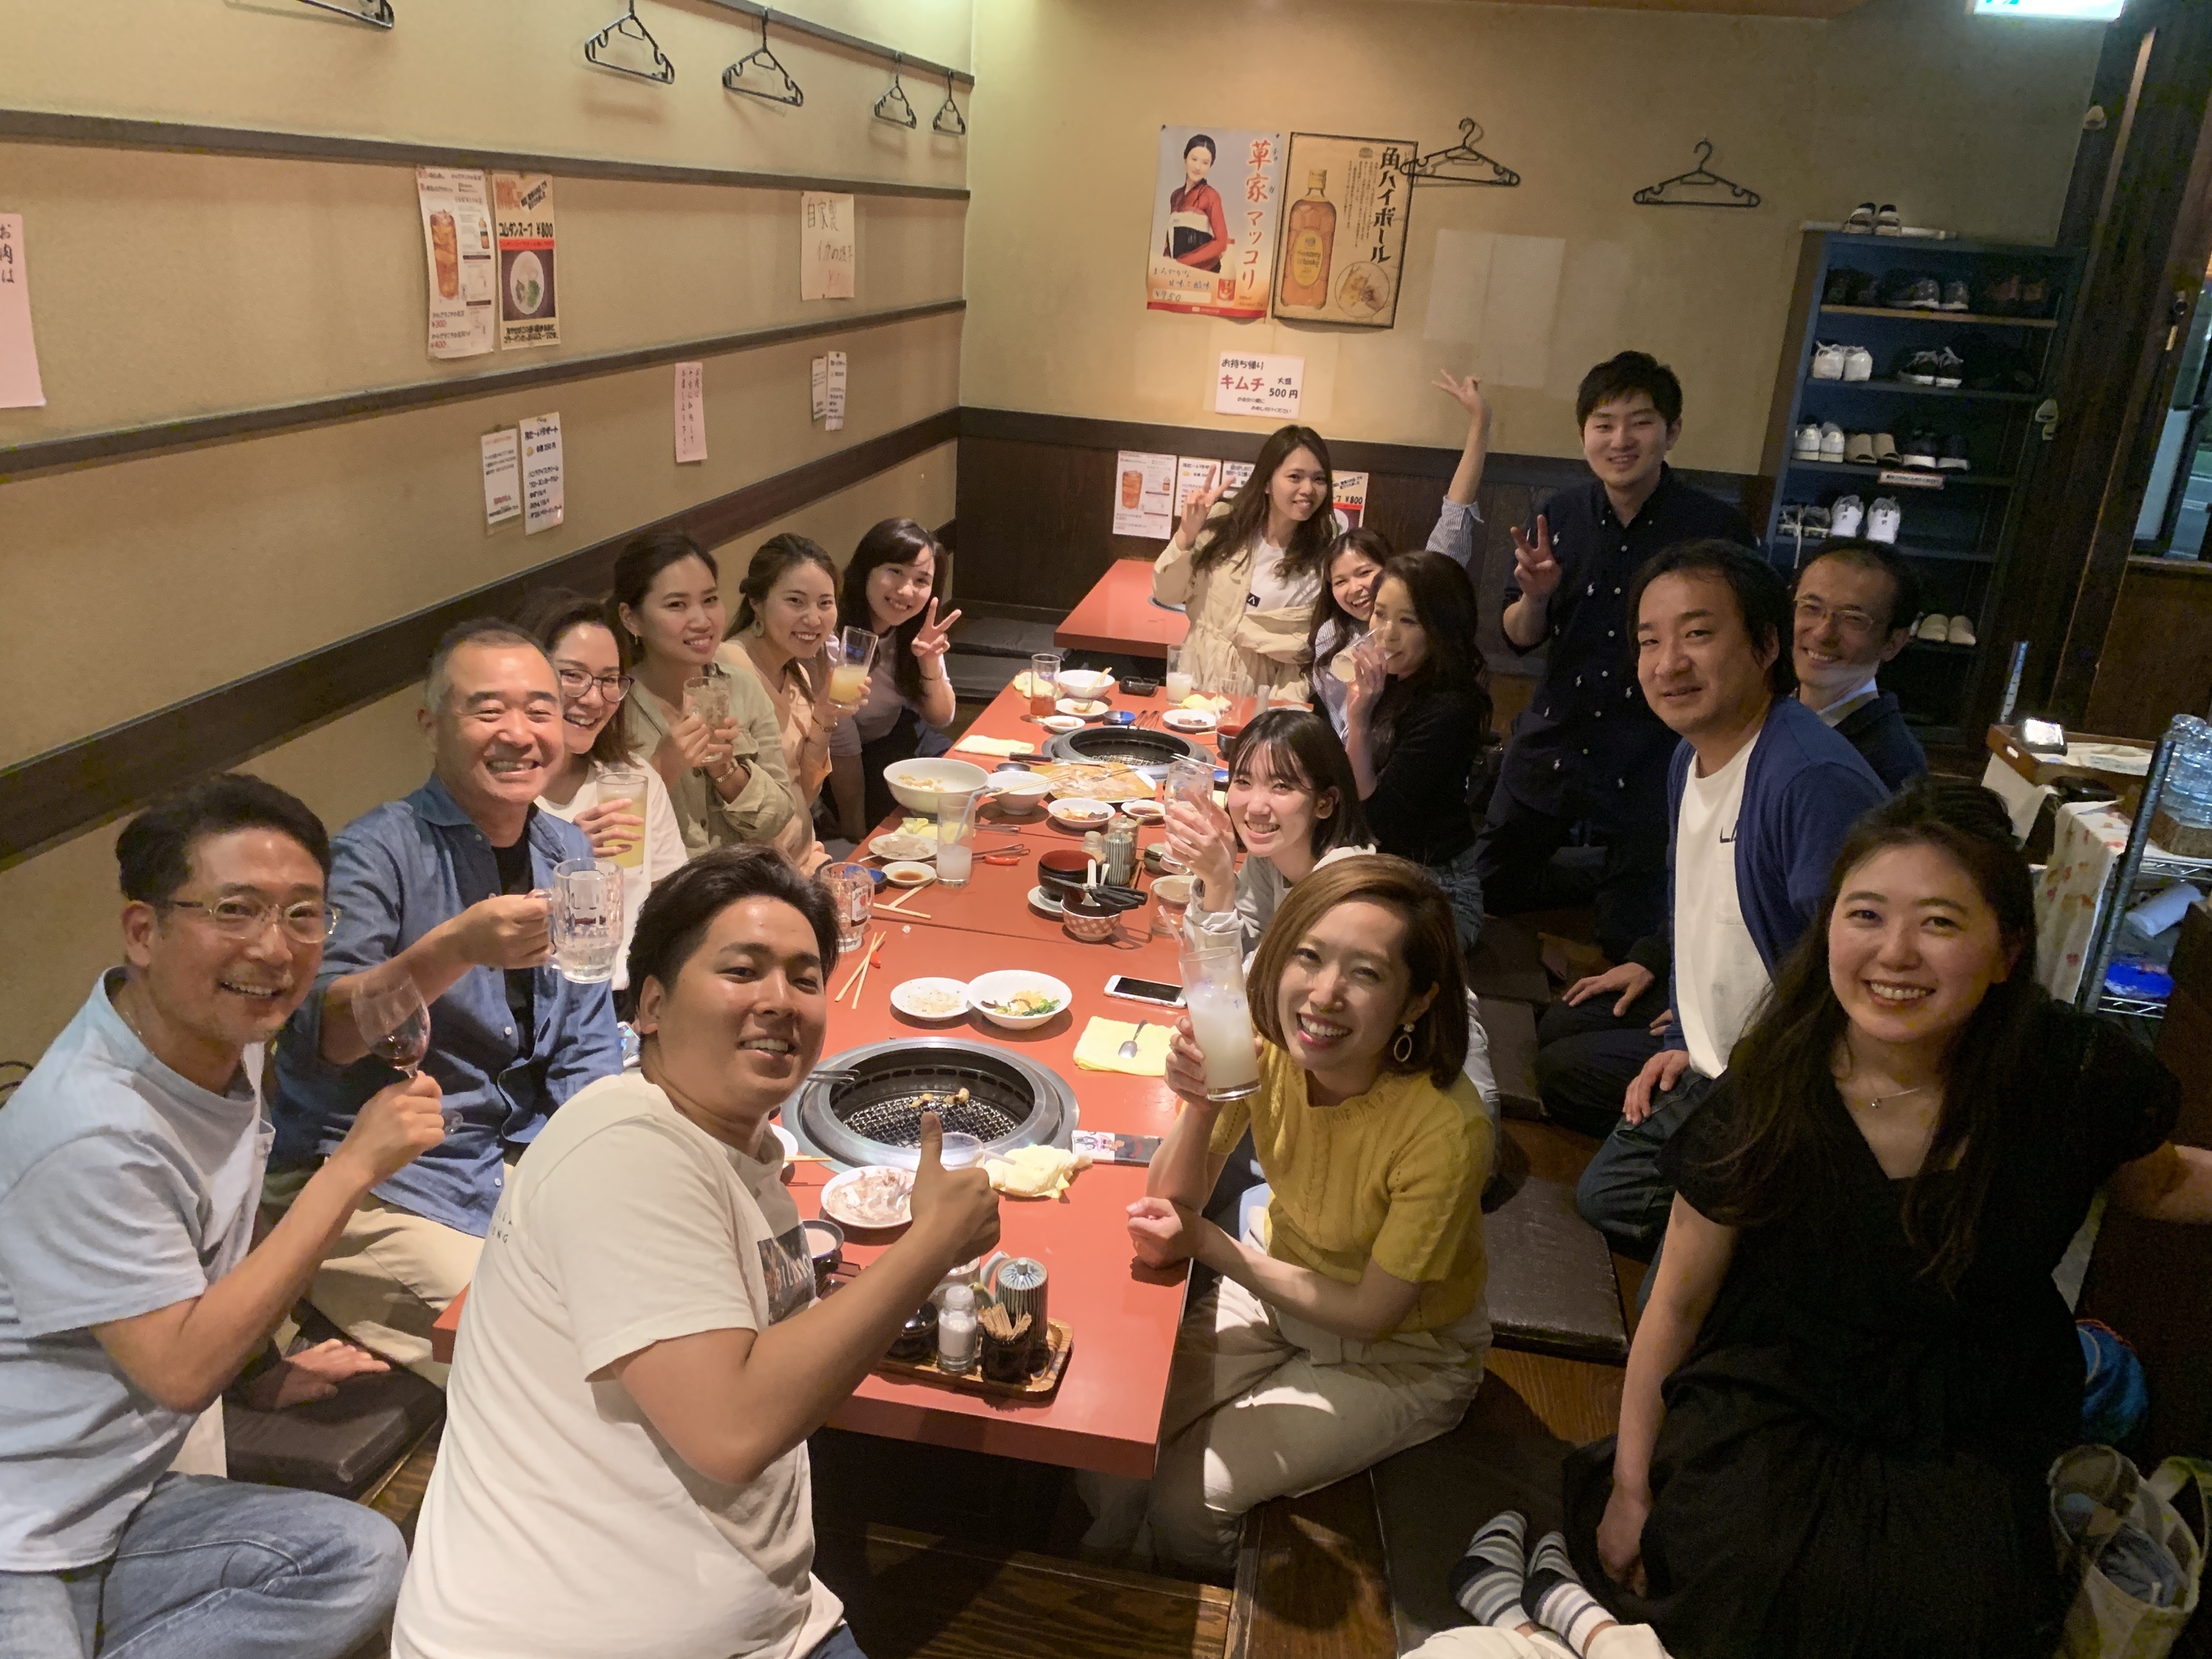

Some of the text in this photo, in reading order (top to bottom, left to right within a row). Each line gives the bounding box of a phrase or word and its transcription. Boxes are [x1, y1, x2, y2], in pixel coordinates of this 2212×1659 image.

[1370, 147, 1400, 263] 角ハイボール
[1242, 140, 1272, 290] 草家マッコリ
[536, 222, 553, 238] ¥800
[1155, 290, 1181, 302] ¥750
[1222, 359, 1263, 370] お持ち帰り
[1220, 375, 1264, 392] キムチ
[1269, 388, 1298, 399] 500円
[1346, 495, 1363, 505] ¥800
